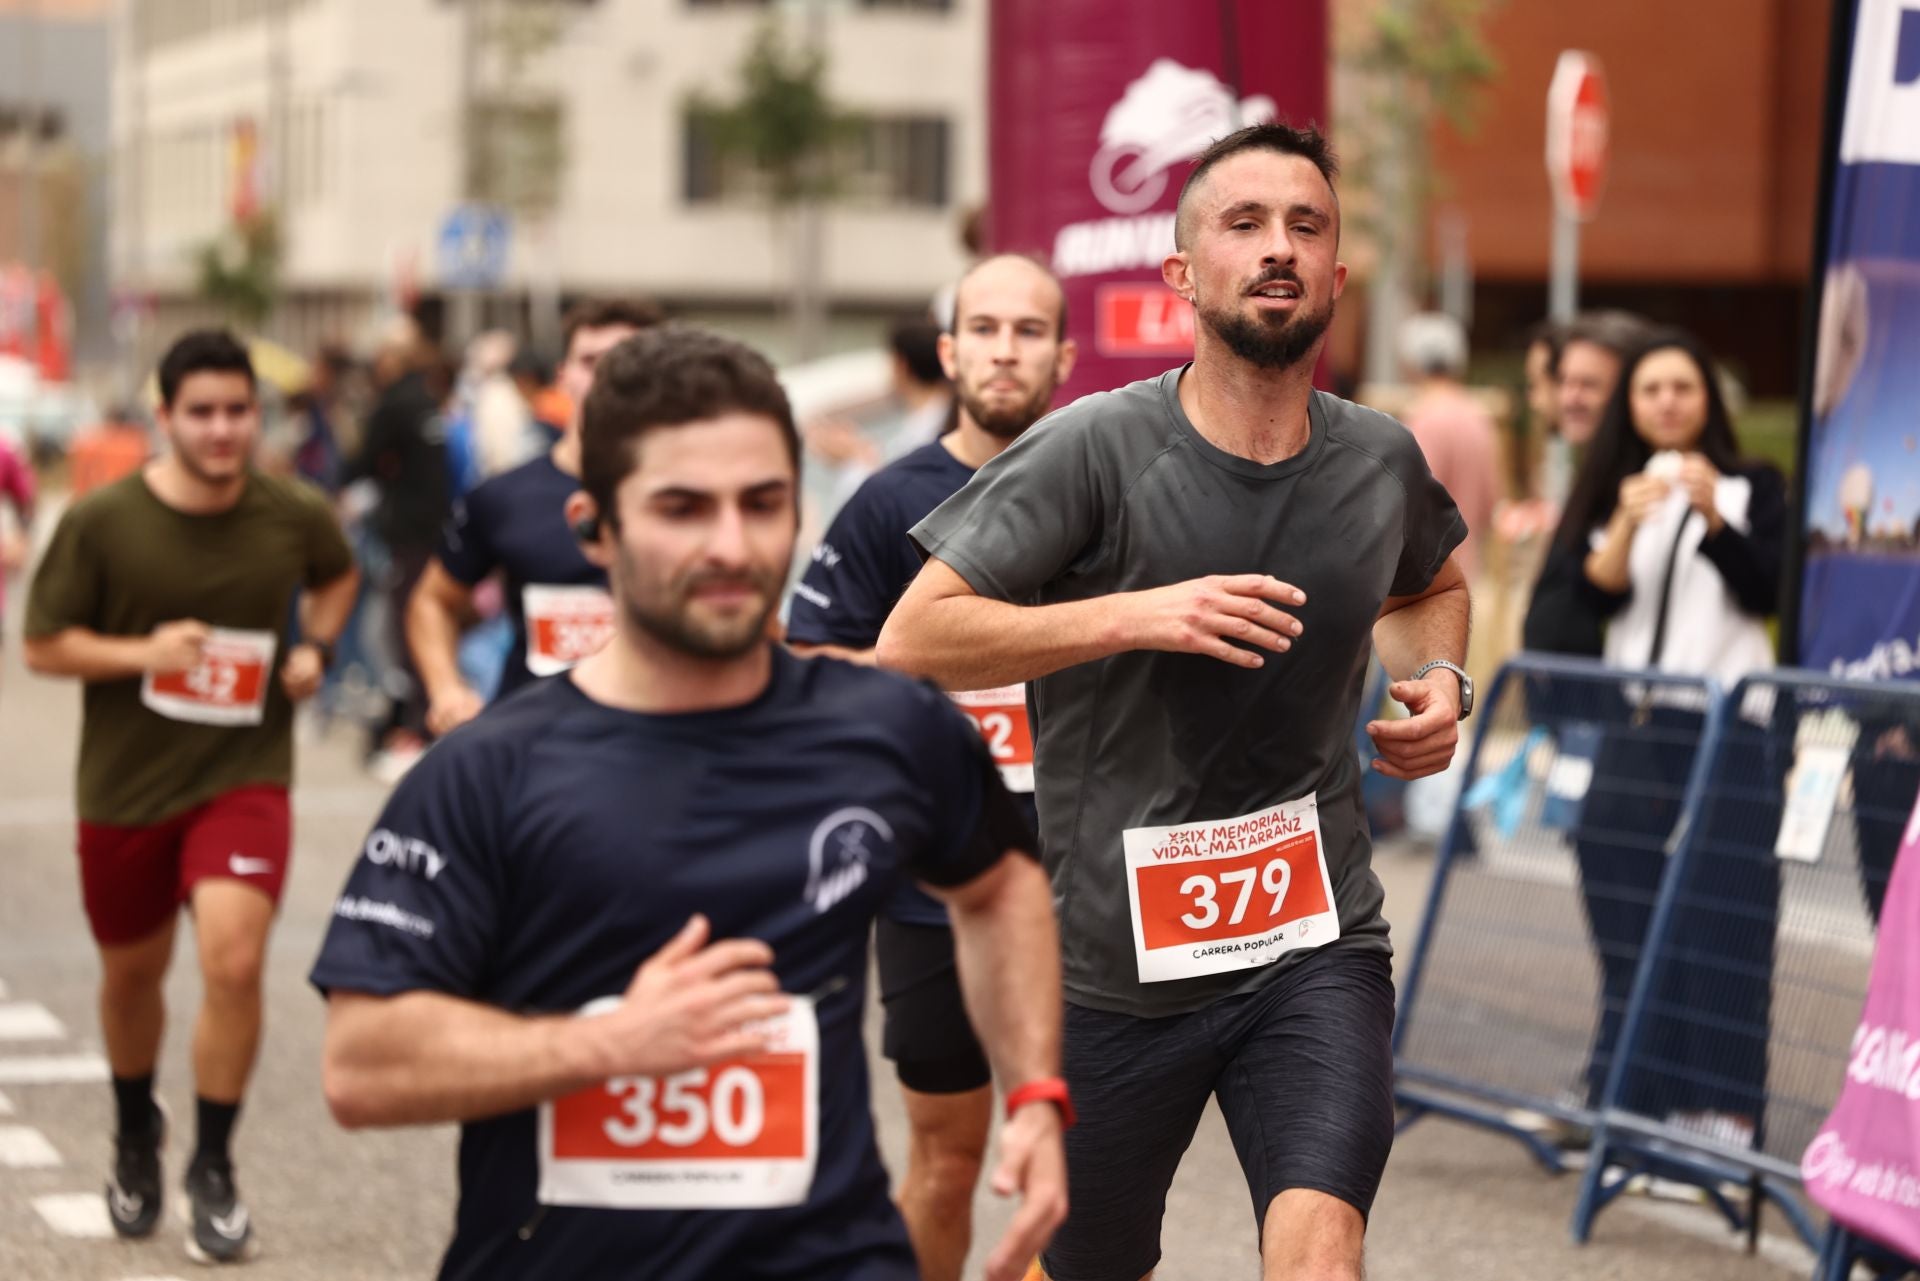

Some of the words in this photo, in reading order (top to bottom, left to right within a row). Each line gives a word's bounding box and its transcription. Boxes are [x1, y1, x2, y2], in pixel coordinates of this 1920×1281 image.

[1151, 816, 1302, 860] VIDAL-MATARRANZ
[1168, 830, 1208, 845] XXIX
[1211, 809, 1288, 841] MEMORIAL
[1179, 858, 1292, 930] 379
[1192, 943, 1241, 959] CARRERA
[1244, 932, 1284, 952] POPULAR
[602, 1066, 765, 1147] 350
